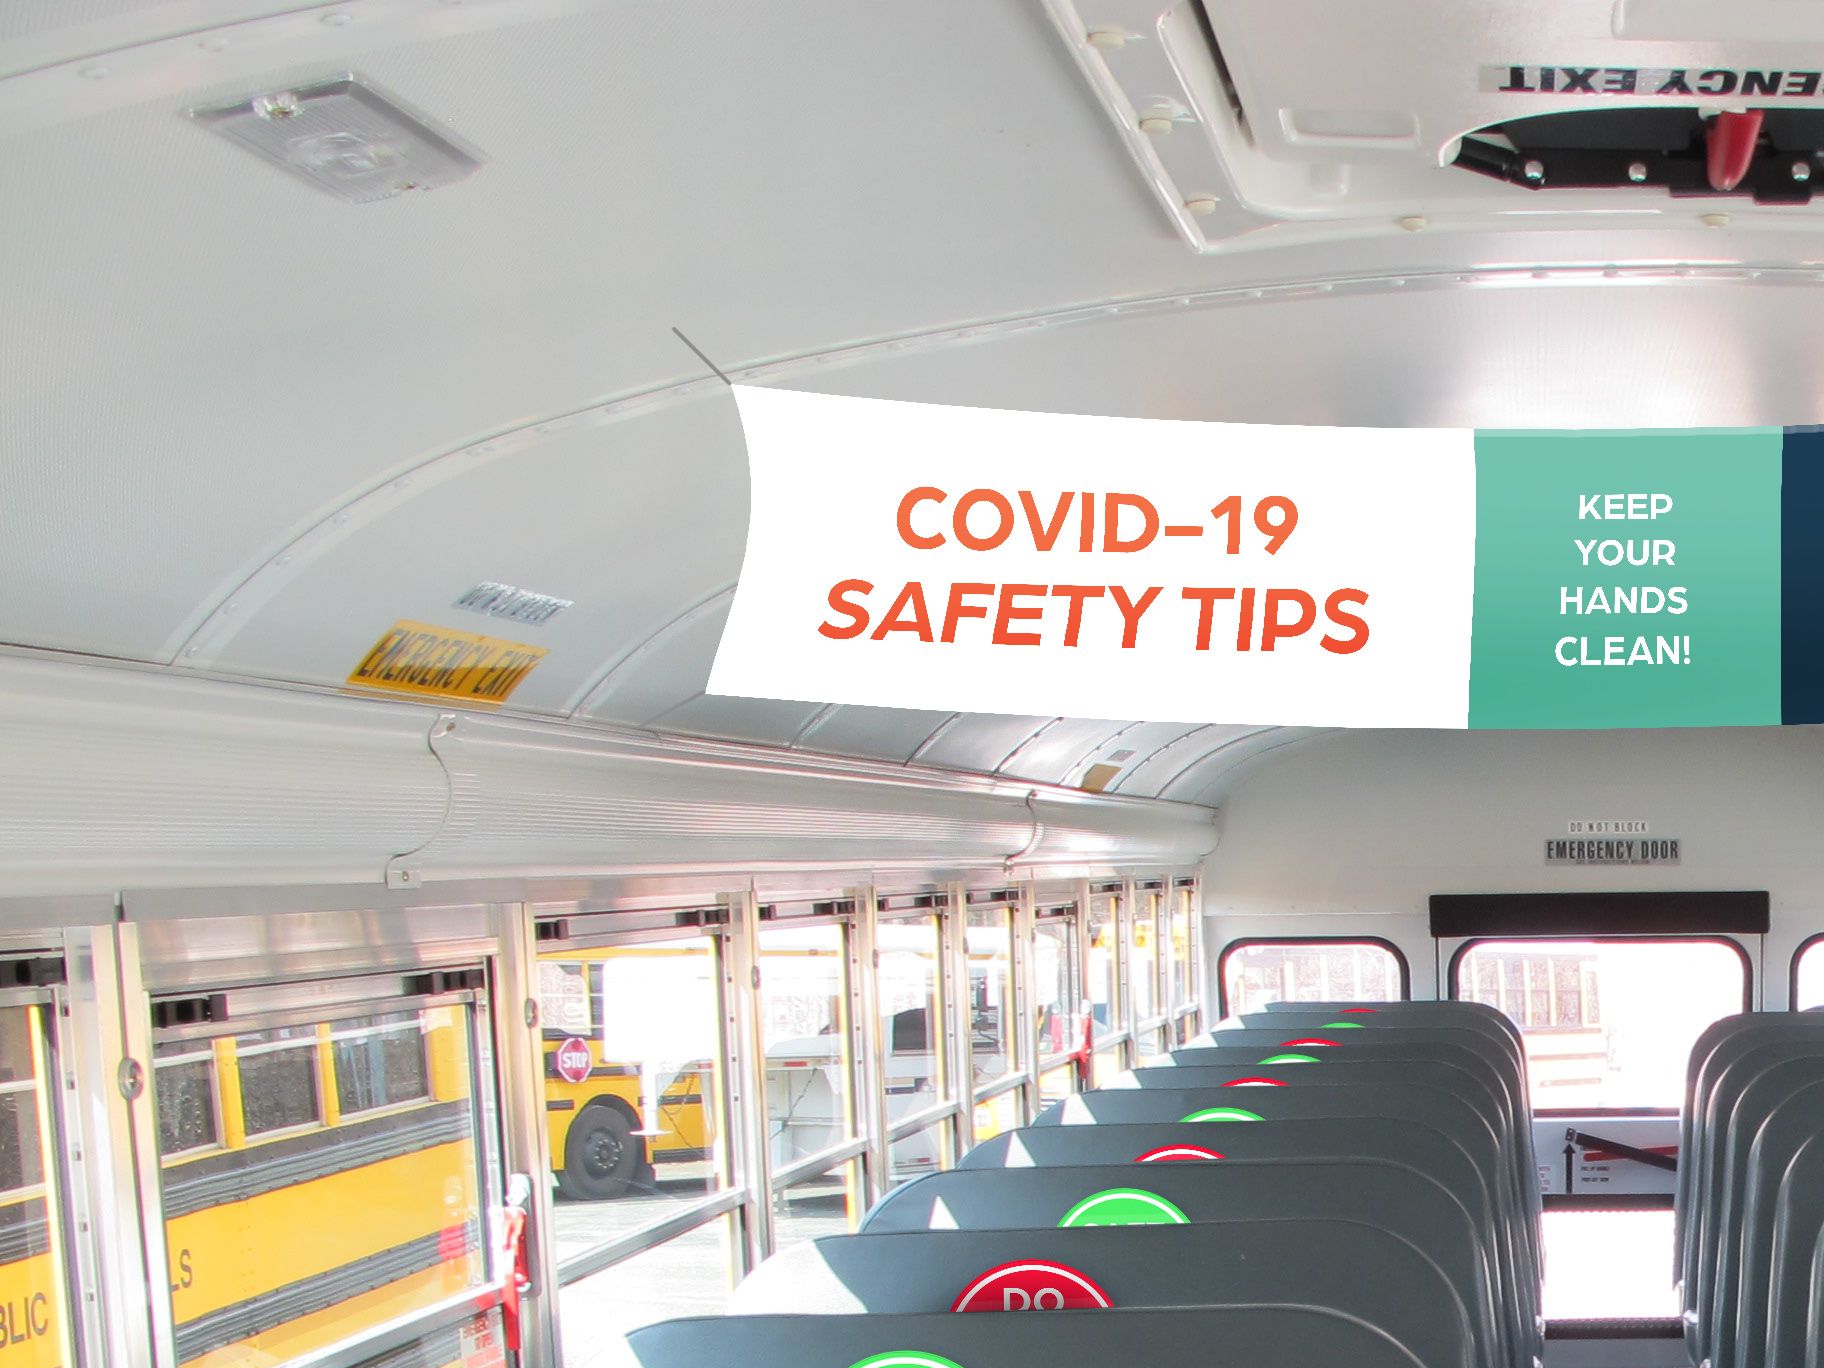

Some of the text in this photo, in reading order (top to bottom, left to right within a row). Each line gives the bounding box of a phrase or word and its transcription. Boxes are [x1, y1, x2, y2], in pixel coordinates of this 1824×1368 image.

[1500, 67, 1639, 94] EXIT
[897, 486, 1299, 556] COVID-19
[1578, 493, 1674, 521] KEEP
[1574, 539, 1676, 567] YOUR
[1560, 586, 1689, 615] HANDS
[817, 578, 1370, 655] SAFETY TIPS
[1554, 635, 1691, 667] CLEAN!
[1570, 822, 1647, 833] DO NOT BLOCK
[1547, 841, 1679, 859] EMERGENCY DOOR
[562, 1051, 588, 1069] STOP
[1003, 1288, 1065, 1311] DO
